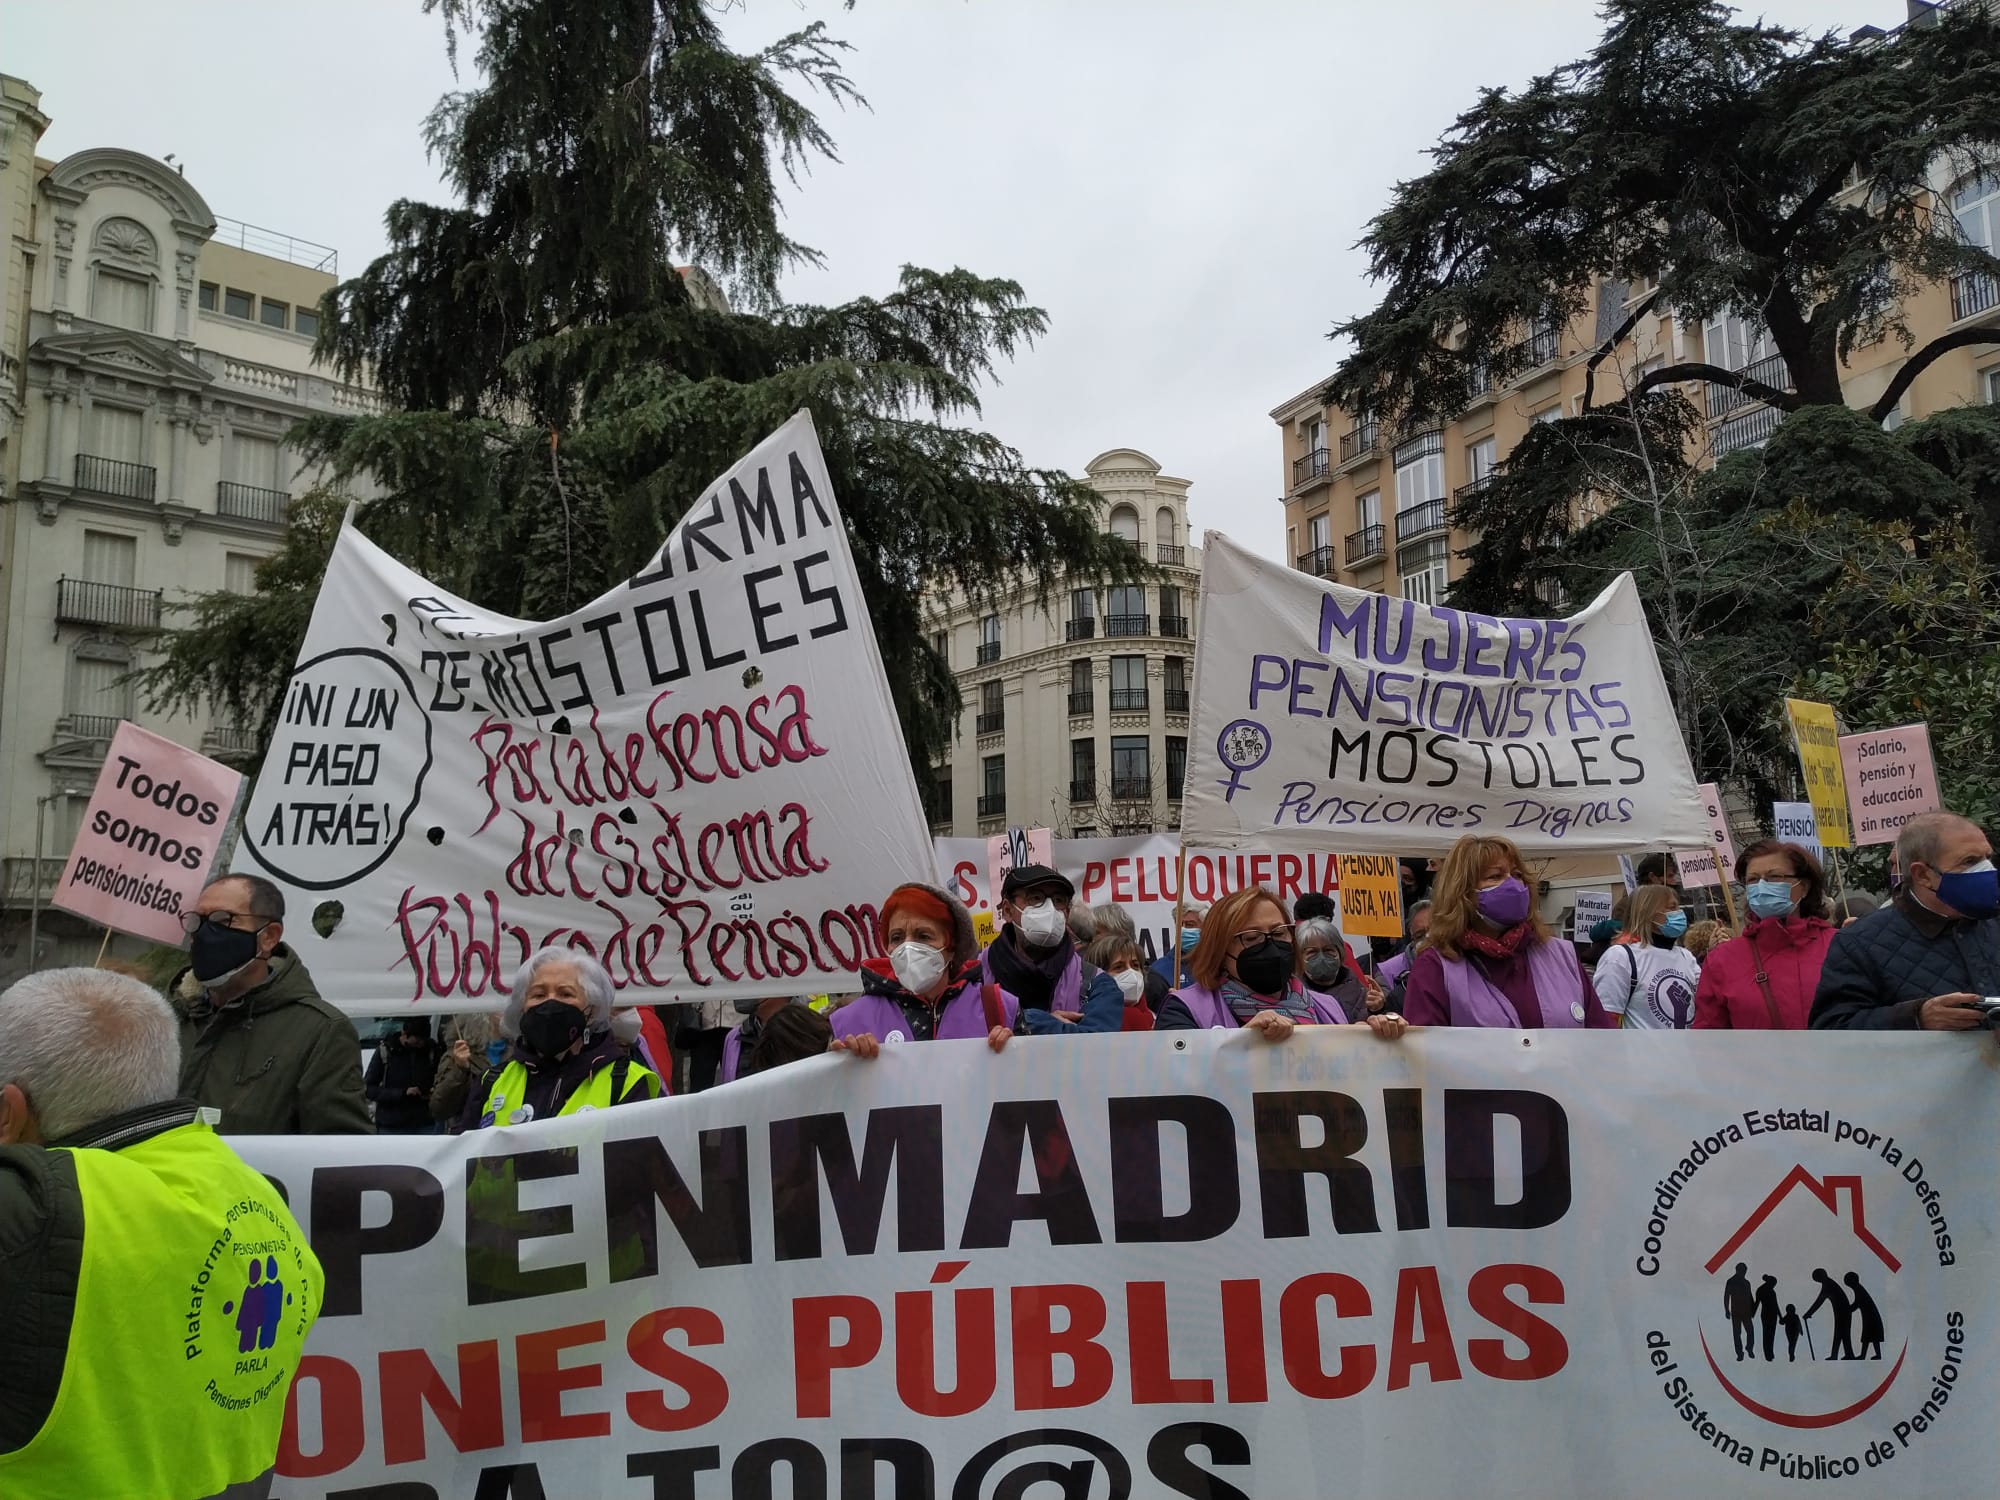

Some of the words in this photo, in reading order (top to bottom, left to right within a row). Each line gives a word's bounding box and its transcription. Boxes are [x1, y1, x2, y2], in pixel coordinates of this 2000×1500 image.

[1318, 592, 1587, 683] MUJERES
[286, 680, 336, 728] ¡NI
[344, 686, 399, 731] UN
[284, 742, 380, 787] PASO
[469, 713, 553, 837] Por
[1328, 726, 1646, 790] MÓSTOLES
[1857, 738, 1907, 763] ¡Salario,
[1859, 762, 1905, 787] pensión
[1909, 763, 1916, 779] y
[114, 755, 220, 827] Todos
[1274, 780, 1488, 827] Pensiones
[1505, 797, 1636, 838] Dignas
[1862, 784, 1924, 807] educación
[91, 808, 204, 871] somos
[260, 793, 392, 847] ATRÁS!
[1861, 817, 1878, 832] sin
[1881, 811, 1918, 830] recor
[505, 808, 600, 900] del
[591, 802, 831, 898] Sistema
[1681, 854, 1732, 878] pensioniss.
[1343, 887, 1378, 922] JUSTA,
[1379, 890, 1398, 917] YA!
[1576, 912, 1584, 921] al
[1585, 913, 1610, 923] mayor
[1577, 898, 1611, 911] Maltratar
[596, 899, 674, 989] de
[264, 1087, 1572, 1318] PENMADRID
[1636, 1122, 1745, 1277] Coordinadora
[1743, 1107, 1831, 1137] Estatal
[1834, 1118, 1883, 1150] por
[1881, 1137, 1904, 1168] la
[1901, 1157, 1957, 1268] Defensa
[184, 1226, 234, 1361] Plataforma
[293, 1246, 303, 1271] de
[204, 1378, 252, 1411] Pensiones
[253, 1367, 285, 1406] Dignas
[234, 1356, 269, 1376] PARLA
[272, 1305, 730, 1479] ONES
[791, 1260, 1570, 1418] PÚBLICAS
[1646, 1329, 1679, 1376] del
[1663, 1376, 1755, 1466] Sistema
[1758, 1446, 1860, 1481] Público
[1864, 1440, 1896, 1469] de
[1892, 1310, 1965, 1448] Pensiones
